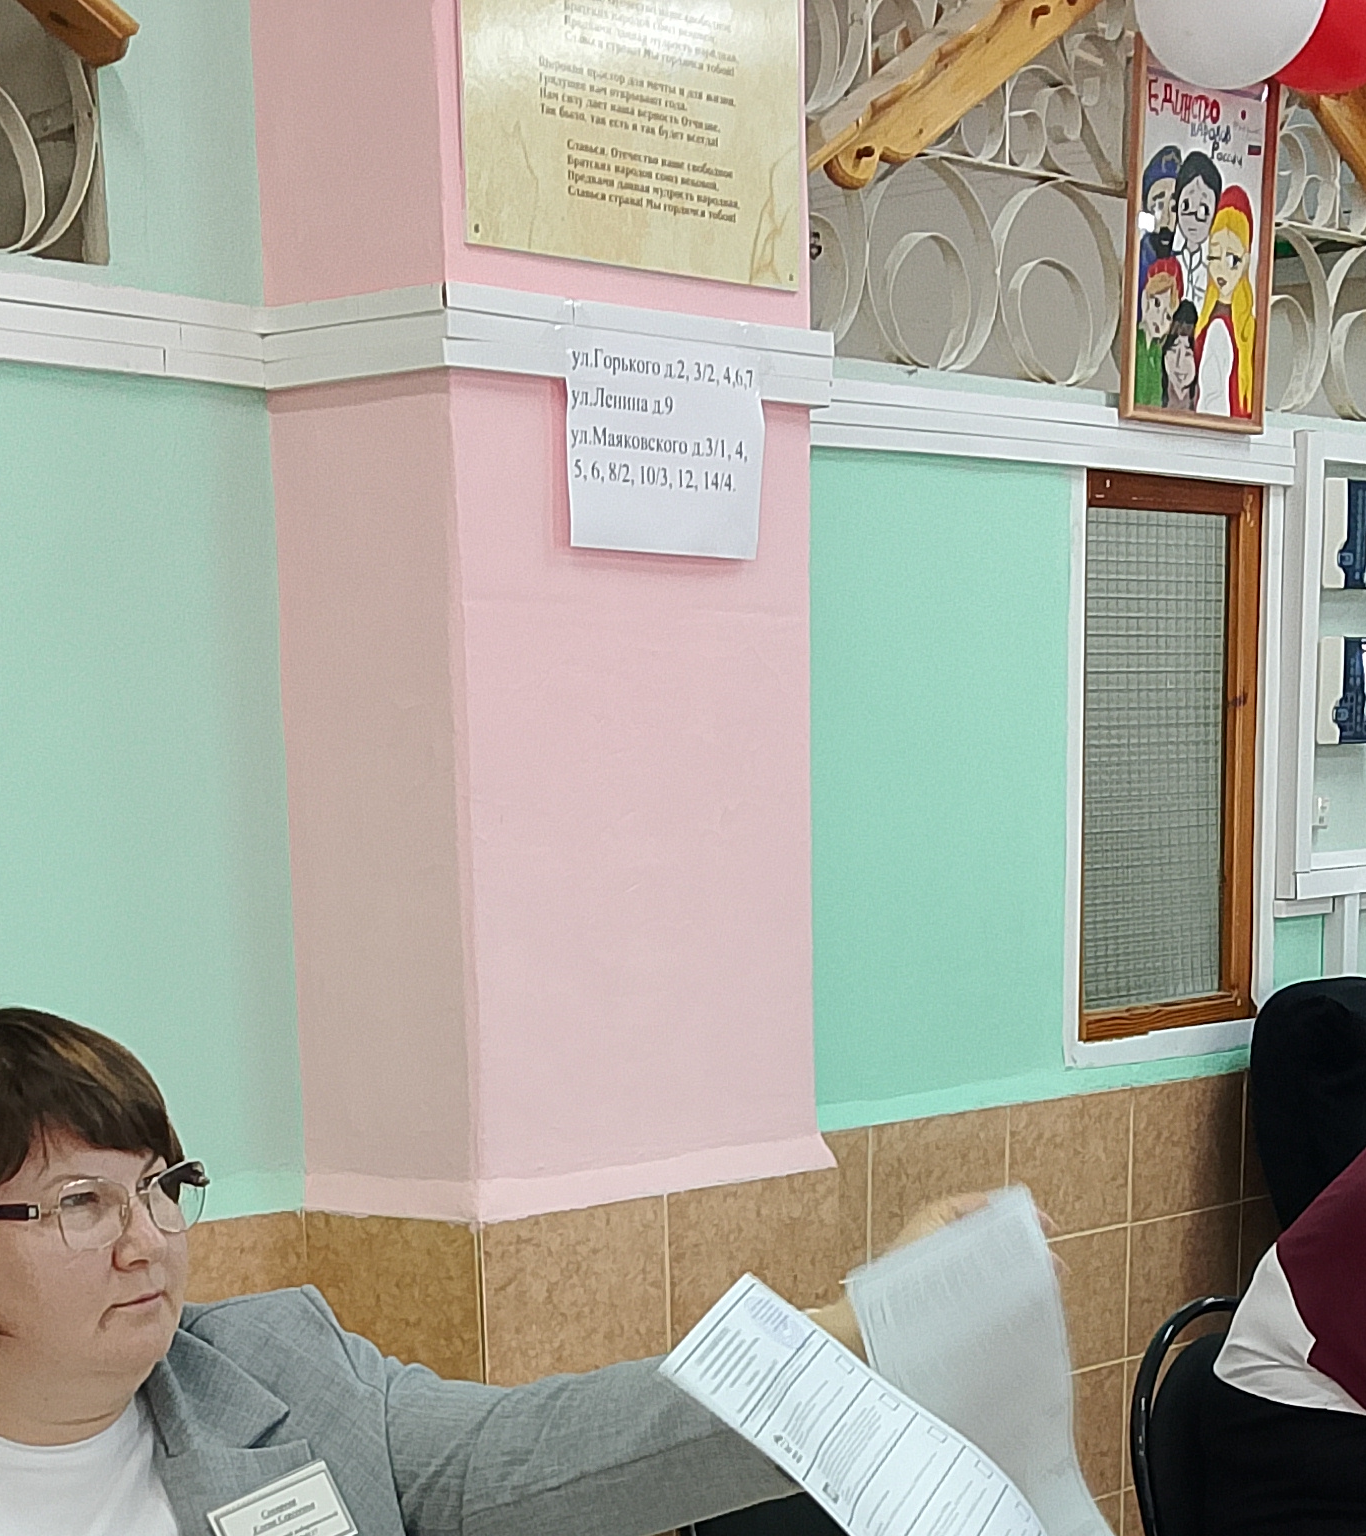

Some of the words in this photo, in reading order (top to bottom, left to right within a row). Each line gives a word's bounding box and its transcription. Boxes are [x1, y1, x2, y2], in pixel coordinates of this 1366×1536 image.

[571, 348, 661, 376] ул.Горького
[693, 362, 720, 387] 3/2,
[571, 386, 648, 413] ул.Ленина
[570, 425, 688, 456] ул.Маяковского
[735, 440, 748, 463] 4,
[573, 458, 588, 482] 5,
[591, 460, 605, 484] 6,
[608, 462, 635, 487] 8/2,
[640, 465, 673, 490] 10/3,
[678, 467, 699, 493] 12,
[704, 470, 737, 493] 14/4.
